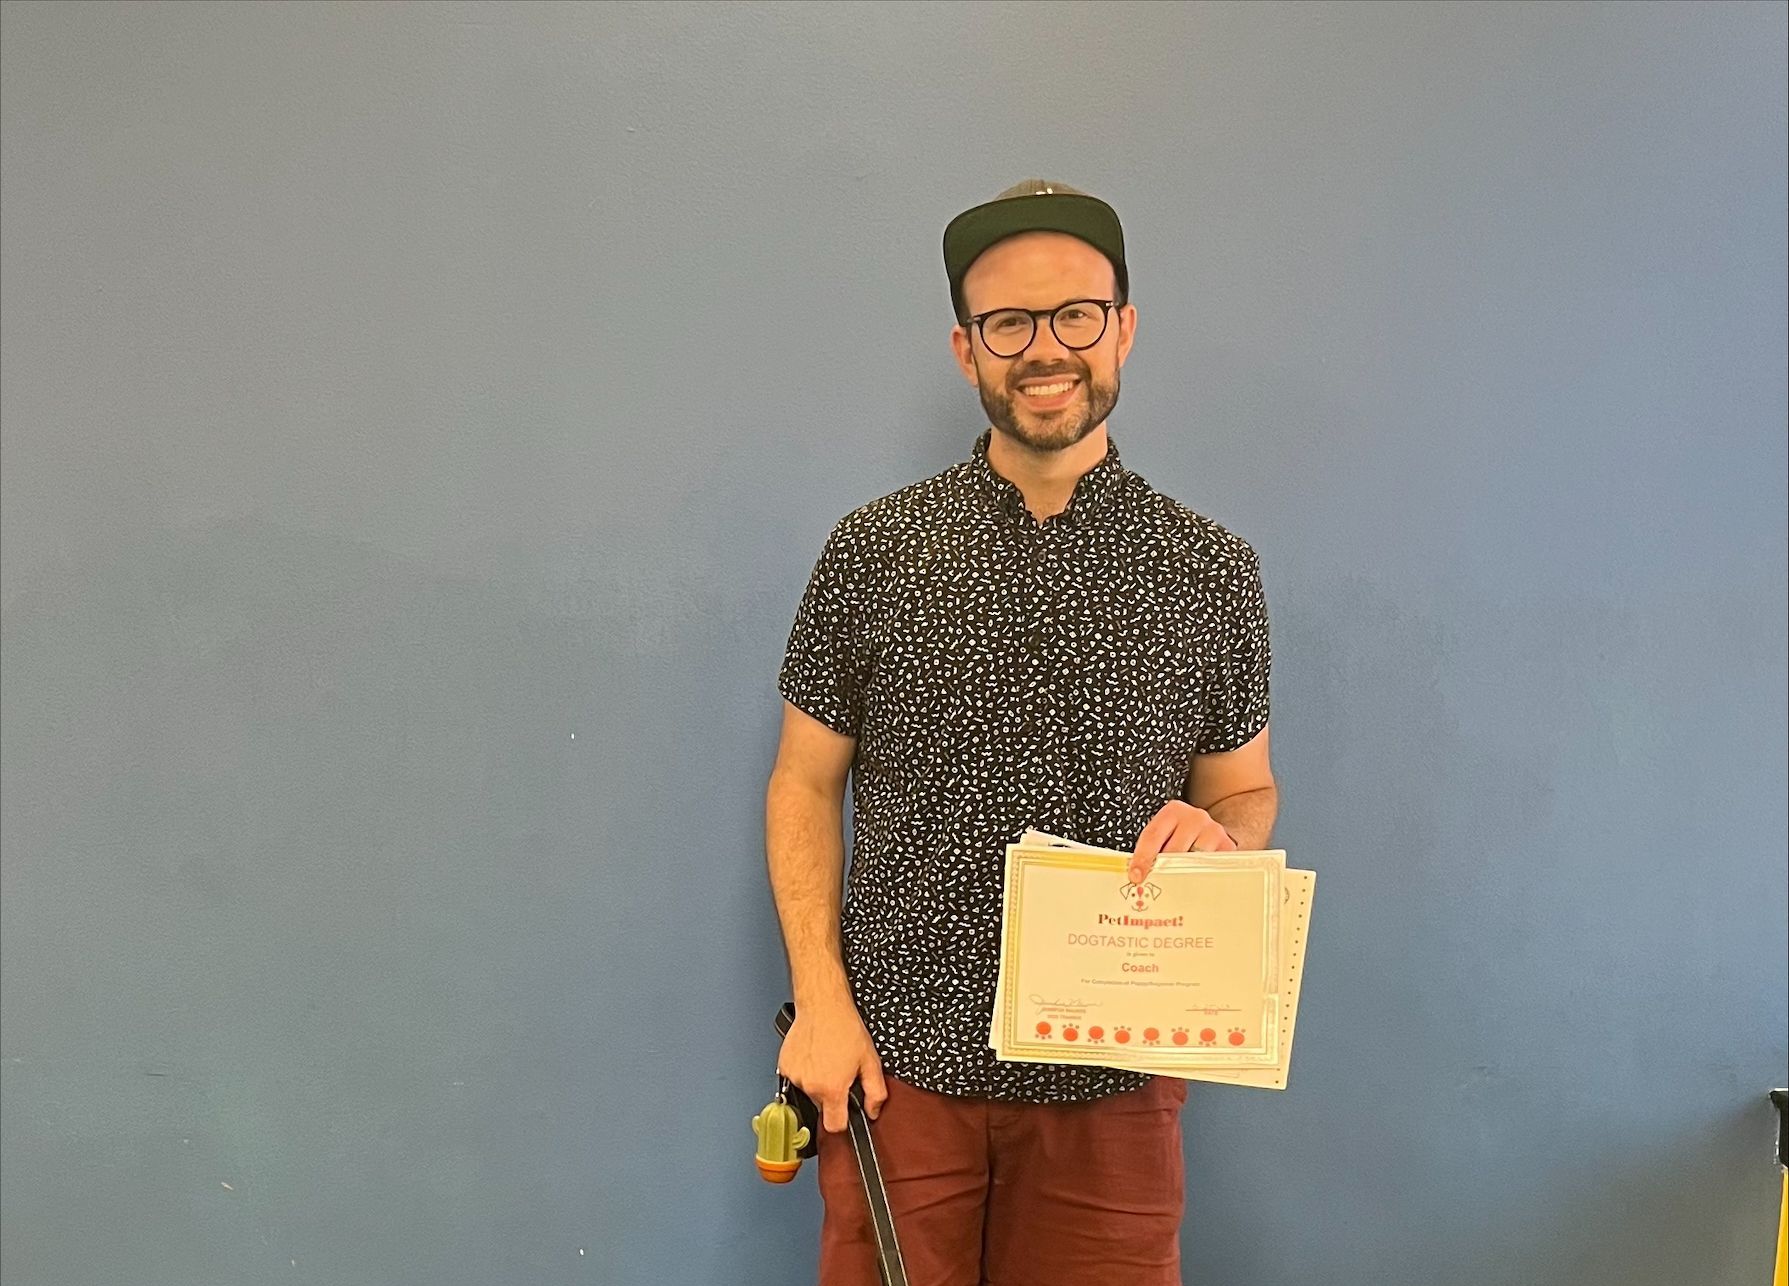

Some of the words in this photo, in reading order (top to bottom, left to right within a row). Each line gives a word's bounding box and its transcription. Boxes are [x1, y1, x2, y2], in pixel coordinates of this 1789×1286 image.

[1098, 913, 1184, 930] PetImpact!
[1067, 932, 1150, 949] DOGTASTIC
[1153, 936, 1215, 950] DEGREE
[1121, 962, 1160, 973] Coach
